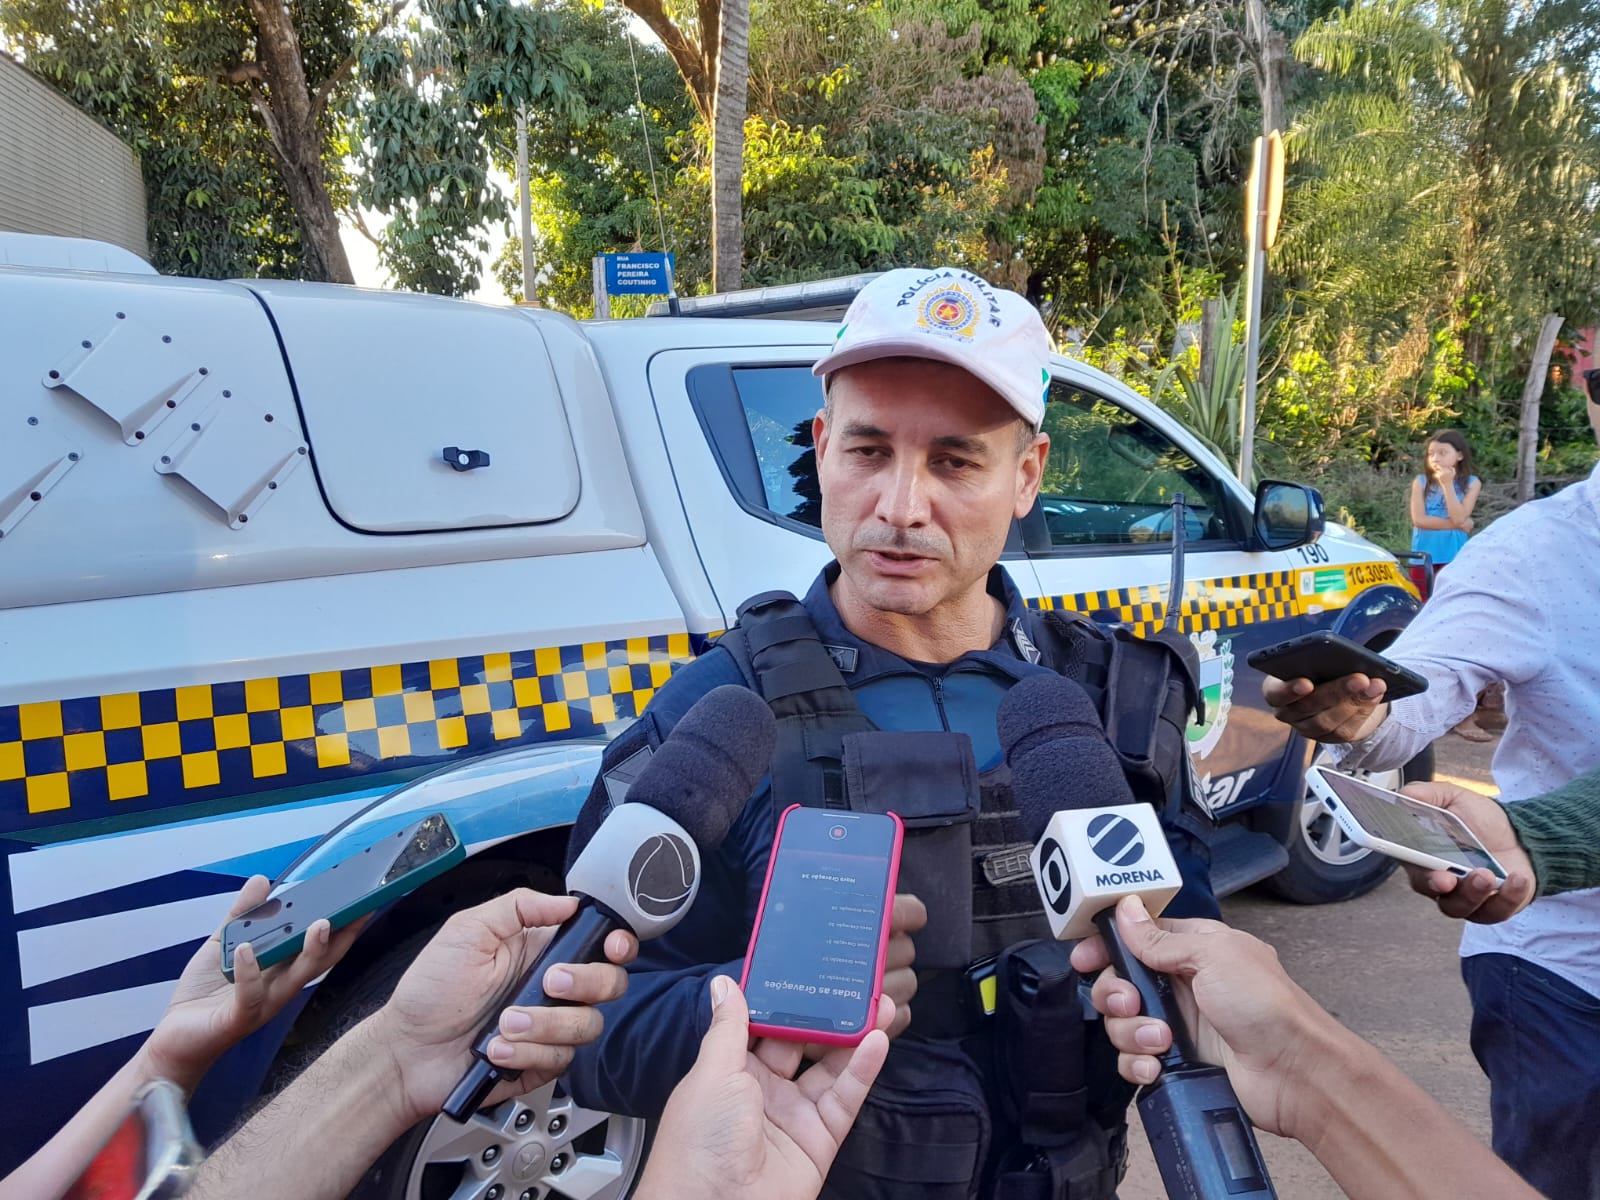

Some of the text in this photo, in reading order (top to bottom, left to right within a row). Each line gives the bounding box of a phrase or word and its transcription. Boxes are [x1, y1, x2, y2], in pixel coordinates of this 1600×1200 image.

[1297, 543, 1329, 564] 190
[1095, 869, 1165, 887] MORENA
[764, 979, 817, 994] Gravações
[832, 989, 862, 1000] Todas
